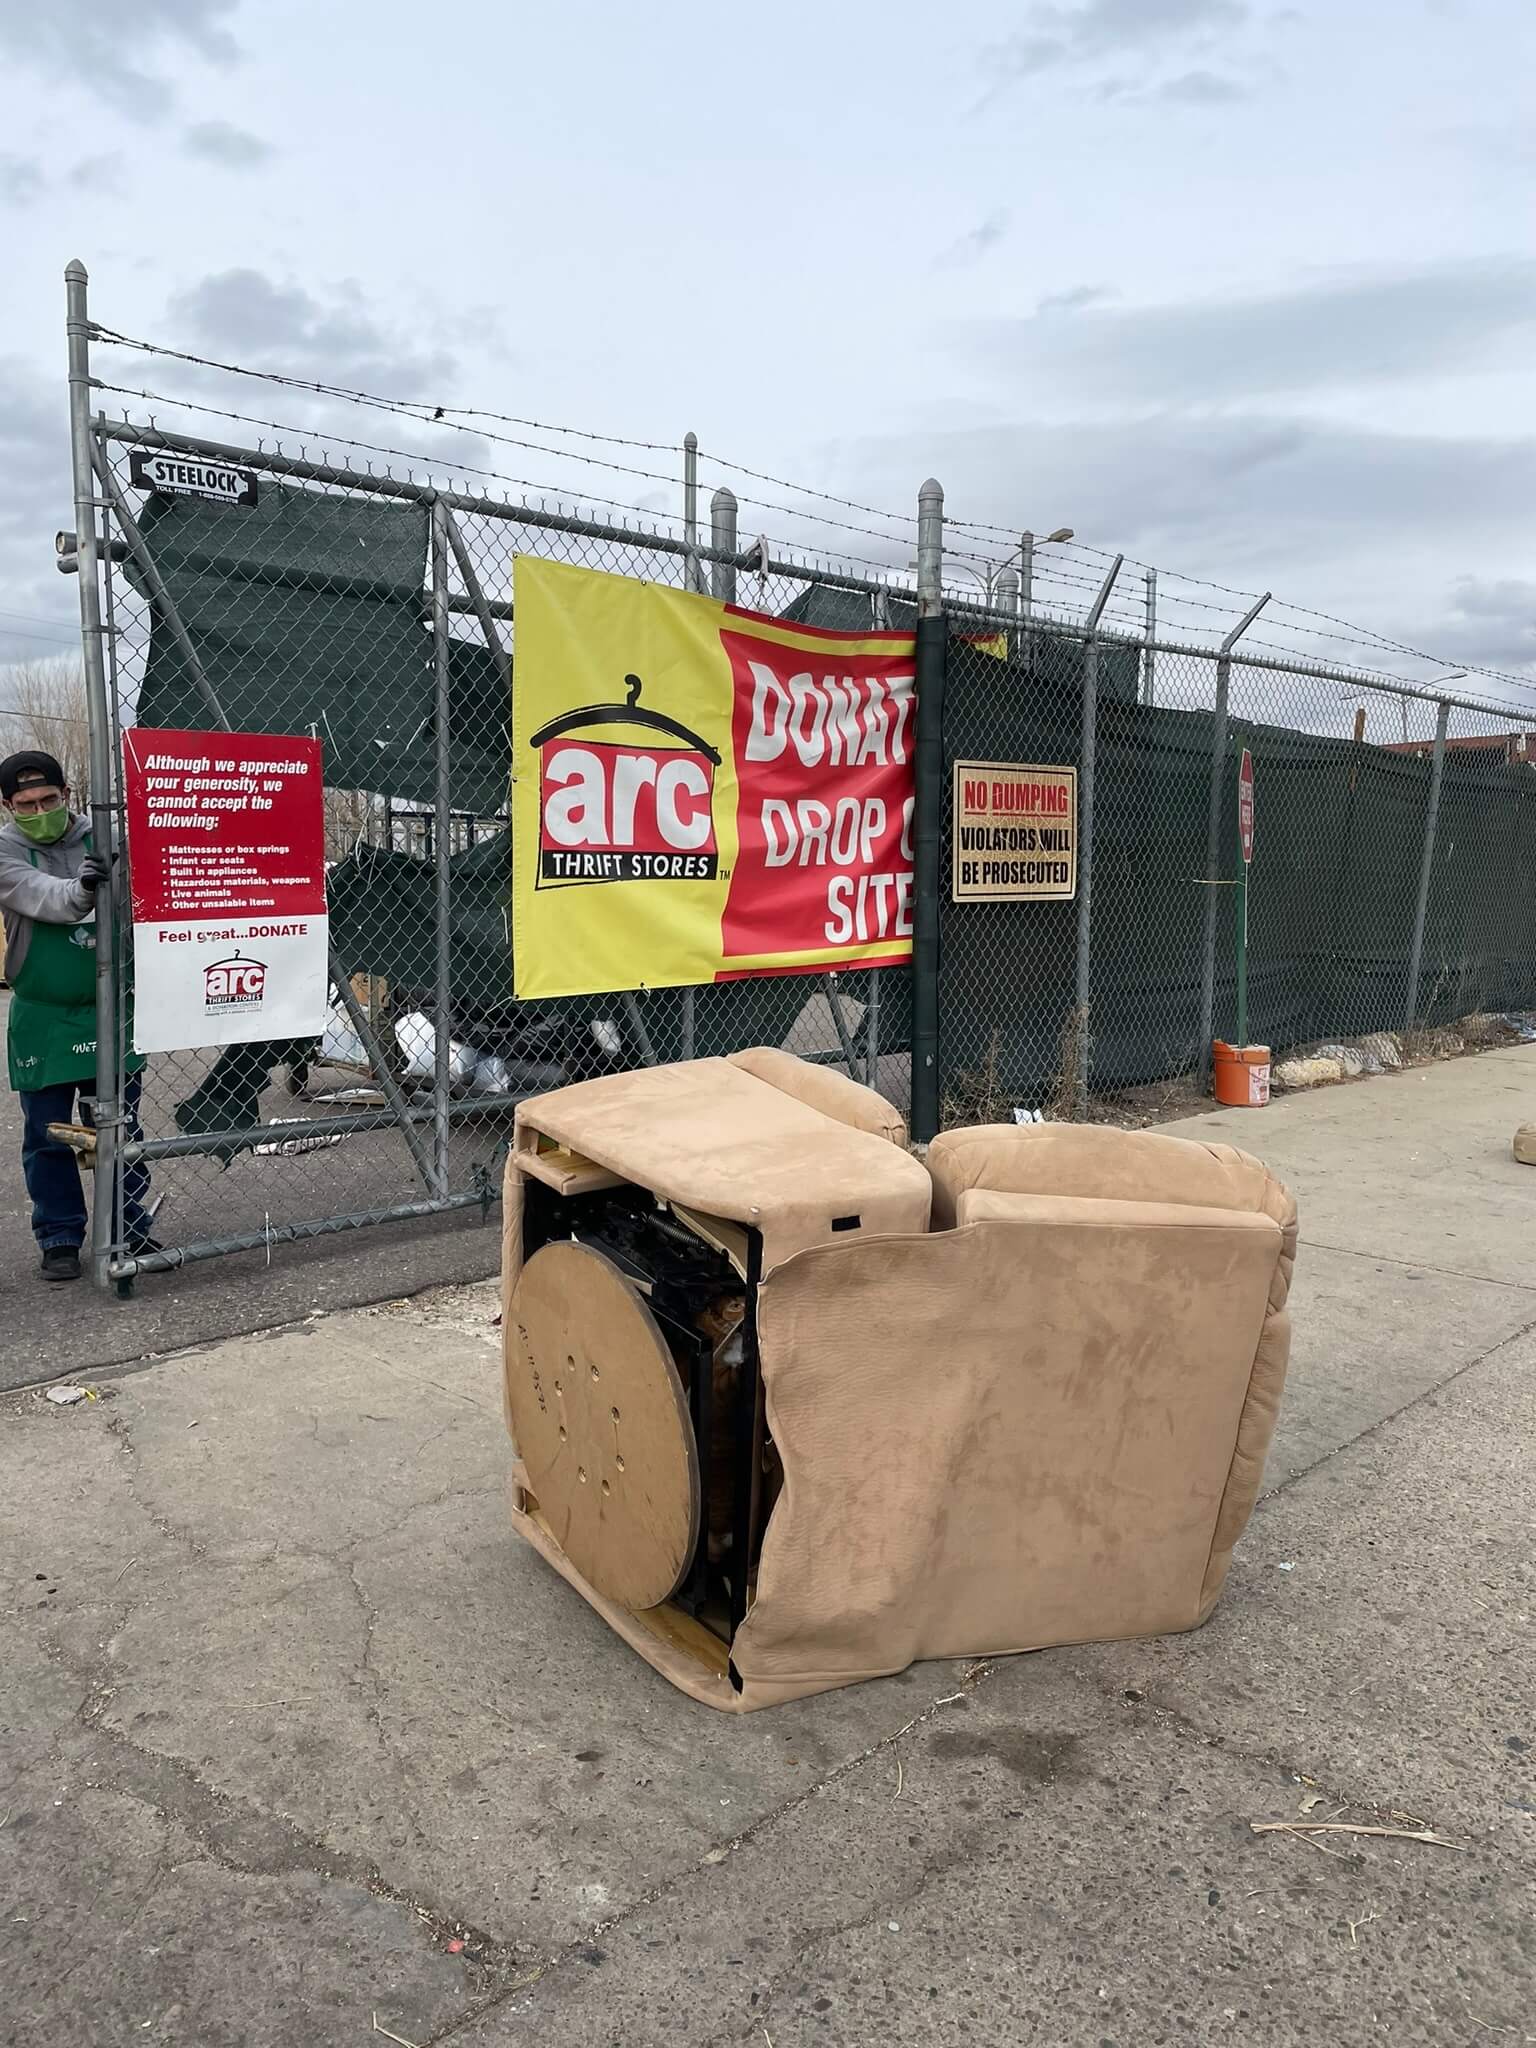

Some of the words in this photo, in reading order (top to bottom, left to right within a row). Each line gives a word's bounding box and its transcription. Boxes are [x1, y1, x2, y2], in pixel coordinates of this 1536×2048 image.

[155, 462, 238, 494] STEELOCK
[174, 488, 192, 496] FREE
[744, 660, 916, 768] DONAT
[144, 755, 210, 774] Although
[215, 760, 236, 772] we
[239, 760, 308, 776] appreciate
[146, 777, 181, 792] your
[184, 777, 259, 794] generosity,
[263, 780, 283, 792] we
[147, 794, 198, 809] cannot
[201, 795, 249, 812] accept
[251, 795, 273, 810] the
[544, 748, 710, 849] arc
[965, 781, 987, 810] NO
[992, 782, 1068, 813] DUMPING
[148, 812, 220, 831] following:
[760, 797, 886, 868] DROP
[961, 827, 1037, 851] VIOLATORS
[1039, 829, 1071, 851] WILL
[169, 845, 223, 855] Mattresses
[225, 846, 236, 854] or
[237, 845, 255, 854] box
[257, 844, 290, 855] springs
[169, 856, 198, 865] Infant
[201, 857, 217, 865] car
[219, 856, 246, 865] seats
[553, 853, 623, 876] THRIFT
[631, 855, 709, 877] STORES
[170, 867, 193, 876] Built
[195, 867, 205, 876] in
[207, 866, 258, 876] appliances
[962, 861, 979, 885] BE
[983, 861, 1069, 885] PROSECUTED
[170, 878, 221, 888] Hazardous
[223, 876, 270, 887] materials,
[271, 876, 311, 886] weapons
[171, 889, 192, 899] Live
[194, 888, 232, 898] animals
[172, 900, 200, 909] Other
[202, 898, 247, 908] unsalable
[249, 897, 275, 907] items
[824, 874, 913, 944] SITE
[159, 930, 192, 943] Feel
[207, 968, 264, 996] arc
[208, 995, 232, 1004] THRIFT
[234, 993, 262, 1002] STORES
